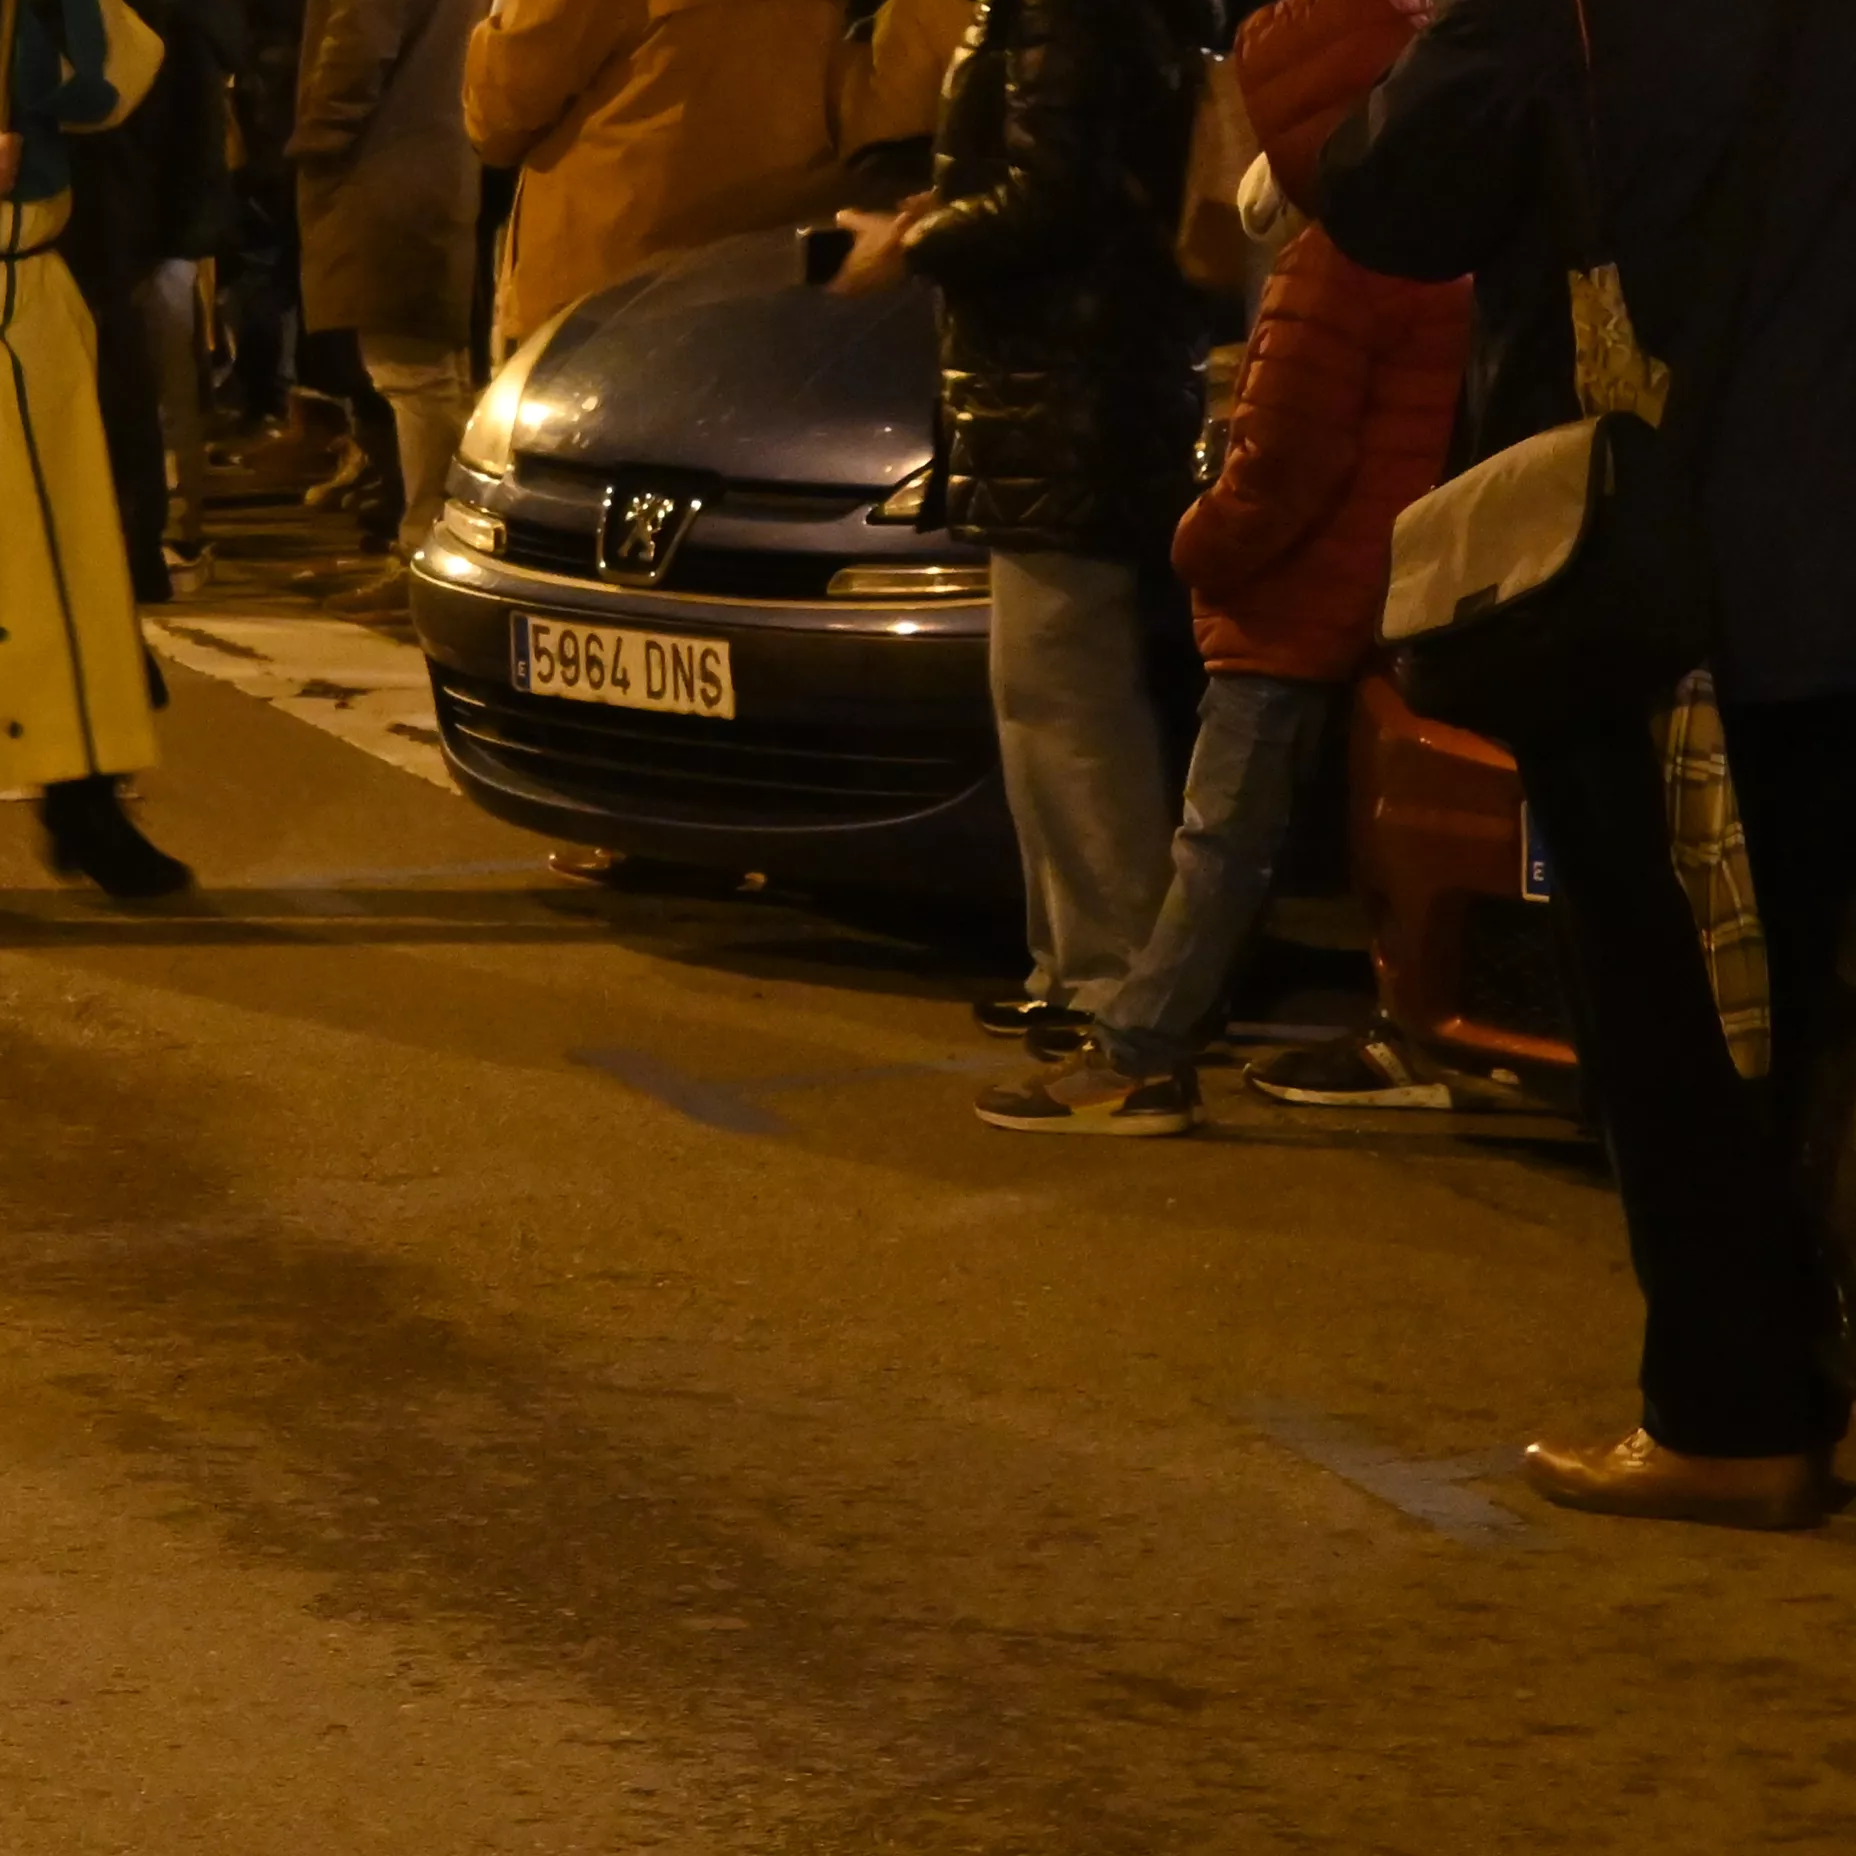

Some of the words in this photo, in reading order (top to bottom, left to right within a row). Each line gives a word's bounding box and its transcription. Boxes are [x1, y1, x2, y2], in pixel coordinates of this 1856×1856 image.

[517, 660, 527, 677] E
[532, 623, 631, 696] 5964
[645, 639, 723, 710] DNS
[1532, 860, 1545, 882] E
